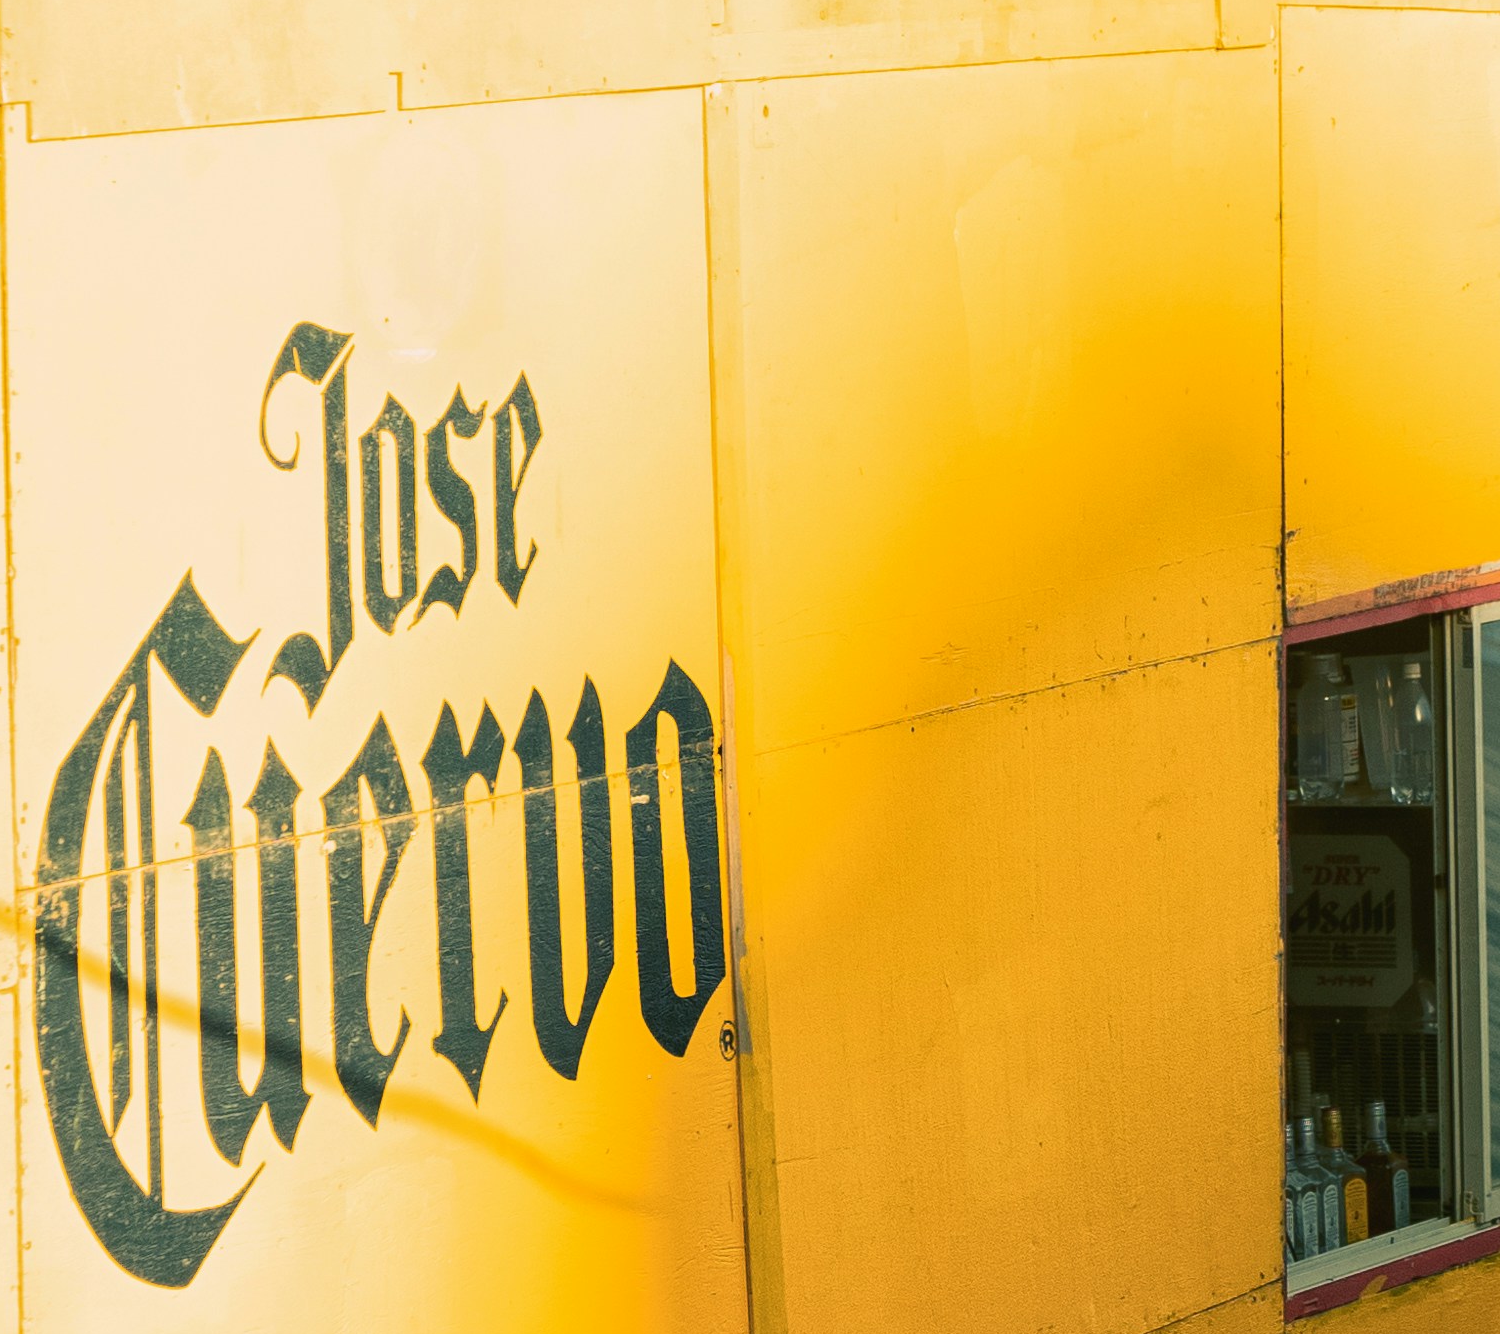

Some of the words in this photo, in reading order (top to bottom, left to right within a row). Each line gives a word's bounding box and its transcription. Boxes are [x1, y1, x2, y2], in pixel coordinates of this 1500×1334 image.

[260, 322, 543, 718] Jose
[33, 568, 727, 1289] Cuervo
[1289, 889, 1396, 935] Asahi
